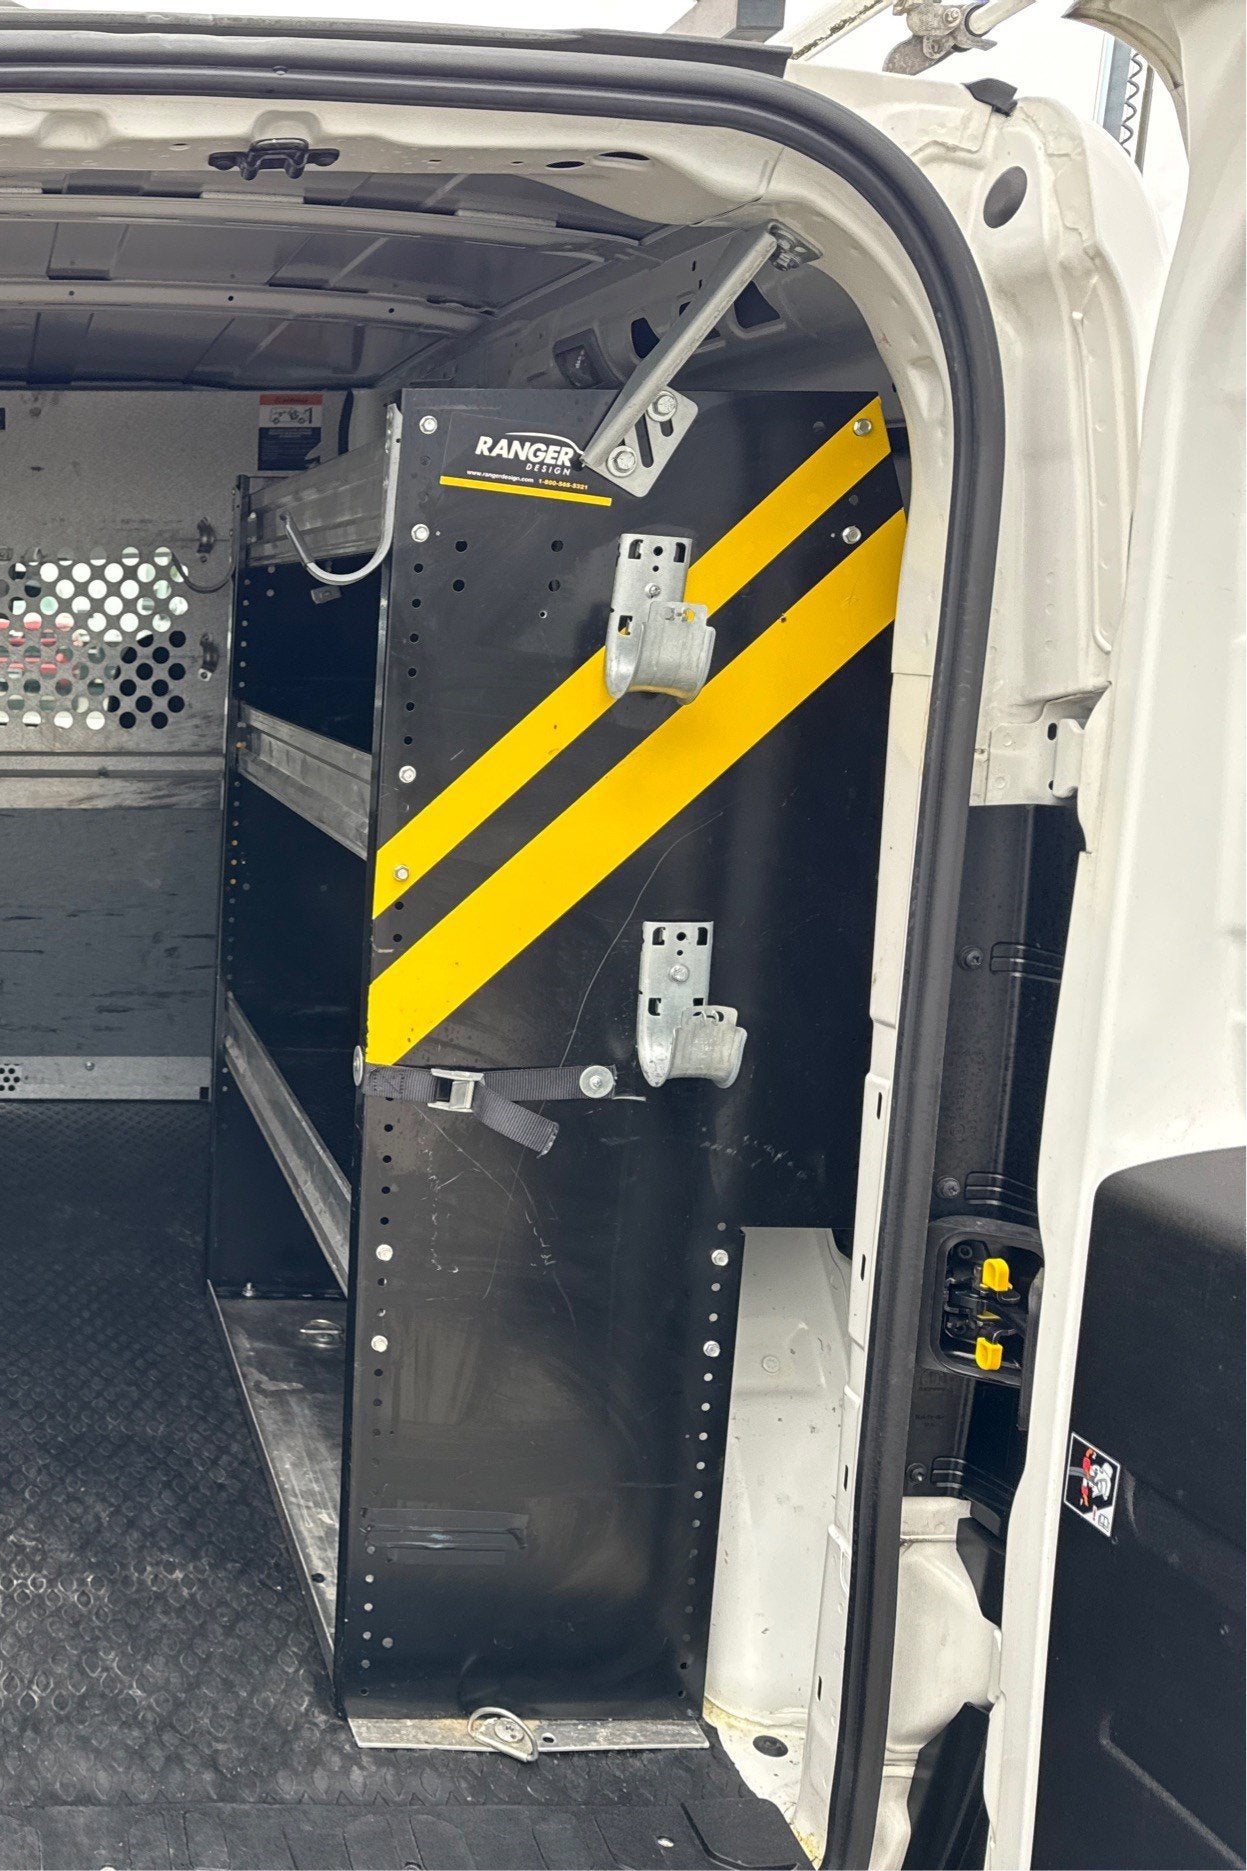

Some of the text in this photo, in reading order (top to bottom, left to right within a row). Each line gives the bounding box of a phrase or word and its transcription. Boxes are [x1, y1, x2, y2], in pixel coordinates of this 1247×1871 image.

[475, 435, 575, 467] RANGER
[466, 469, 534, 483] www.rangerdesign.com
[525, 463, 571, 476] DESIGN
